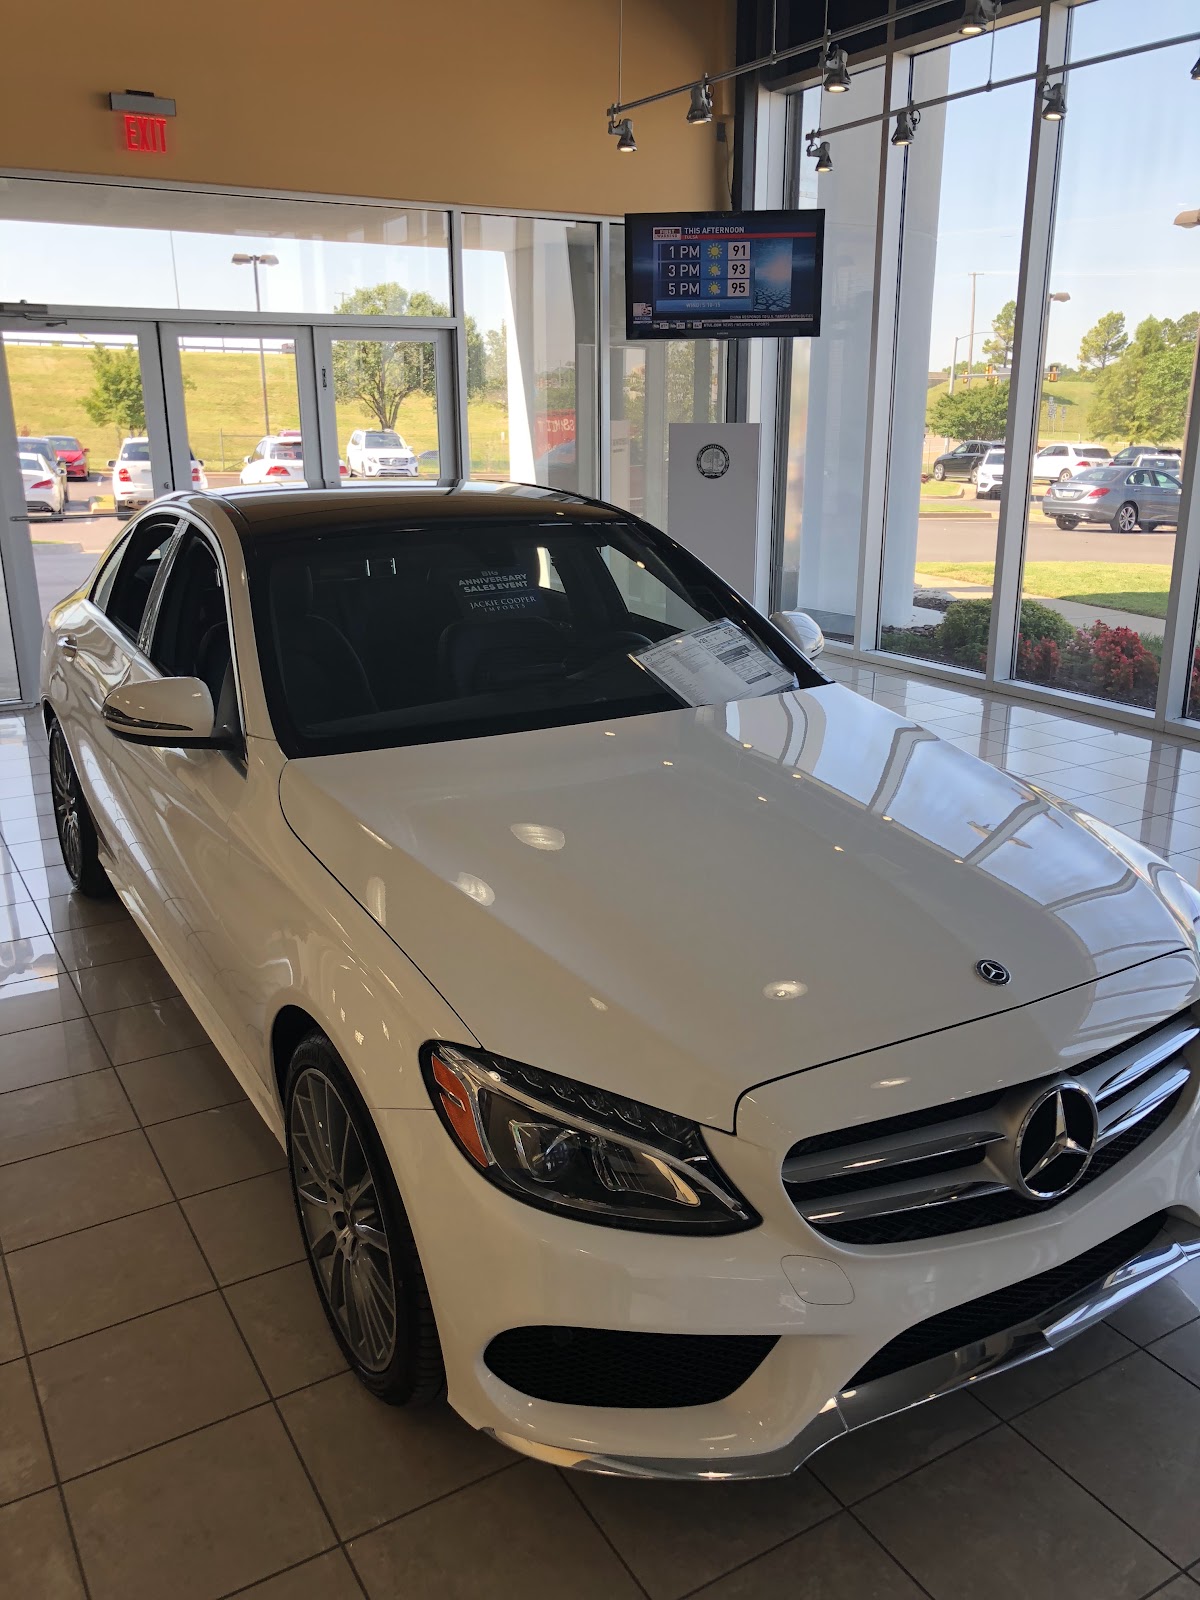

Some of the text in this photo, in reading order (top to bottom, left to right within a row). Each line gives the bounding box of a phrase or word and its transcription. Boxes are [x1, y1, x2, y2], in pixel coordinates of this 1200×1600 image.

[124, 114, 167, 153] EXIT
[684, 226, 745, 235] THIS AFTERNOON
[669, 244, 746, 259] 1 PM 91
[668, 263, 746, 277] 3 PM 93
[668, 282, 746, 296] 5 PM 95
[458, 573, 527, 586] ANNIVERSARY
[463, 580, 528, 593] SALES EVENT
[470, 595, 537, 610] JACKIE COOPER
[484, 603, 526, 613] IMPORTS
